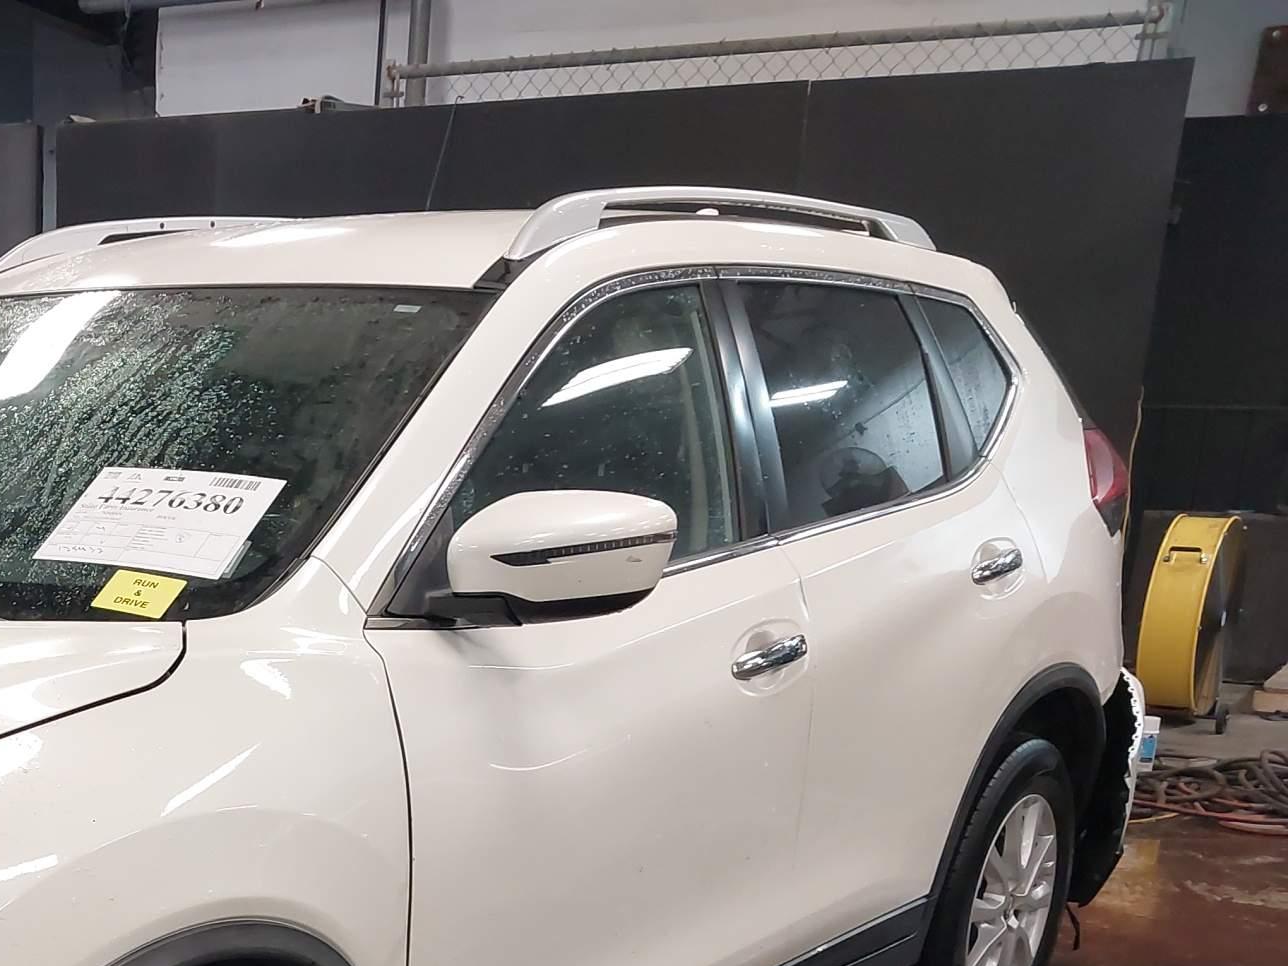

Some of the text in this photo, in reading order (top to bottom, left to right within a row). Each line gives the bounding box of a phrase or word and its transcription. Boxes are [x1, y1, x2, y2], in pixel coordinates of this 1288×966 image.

[98, 486, 245, 515] 44276380
[133, 578, 160, 590] RUN
[133, 589, 143, 598] &
[113, 596, 151, 609] DRIVE
